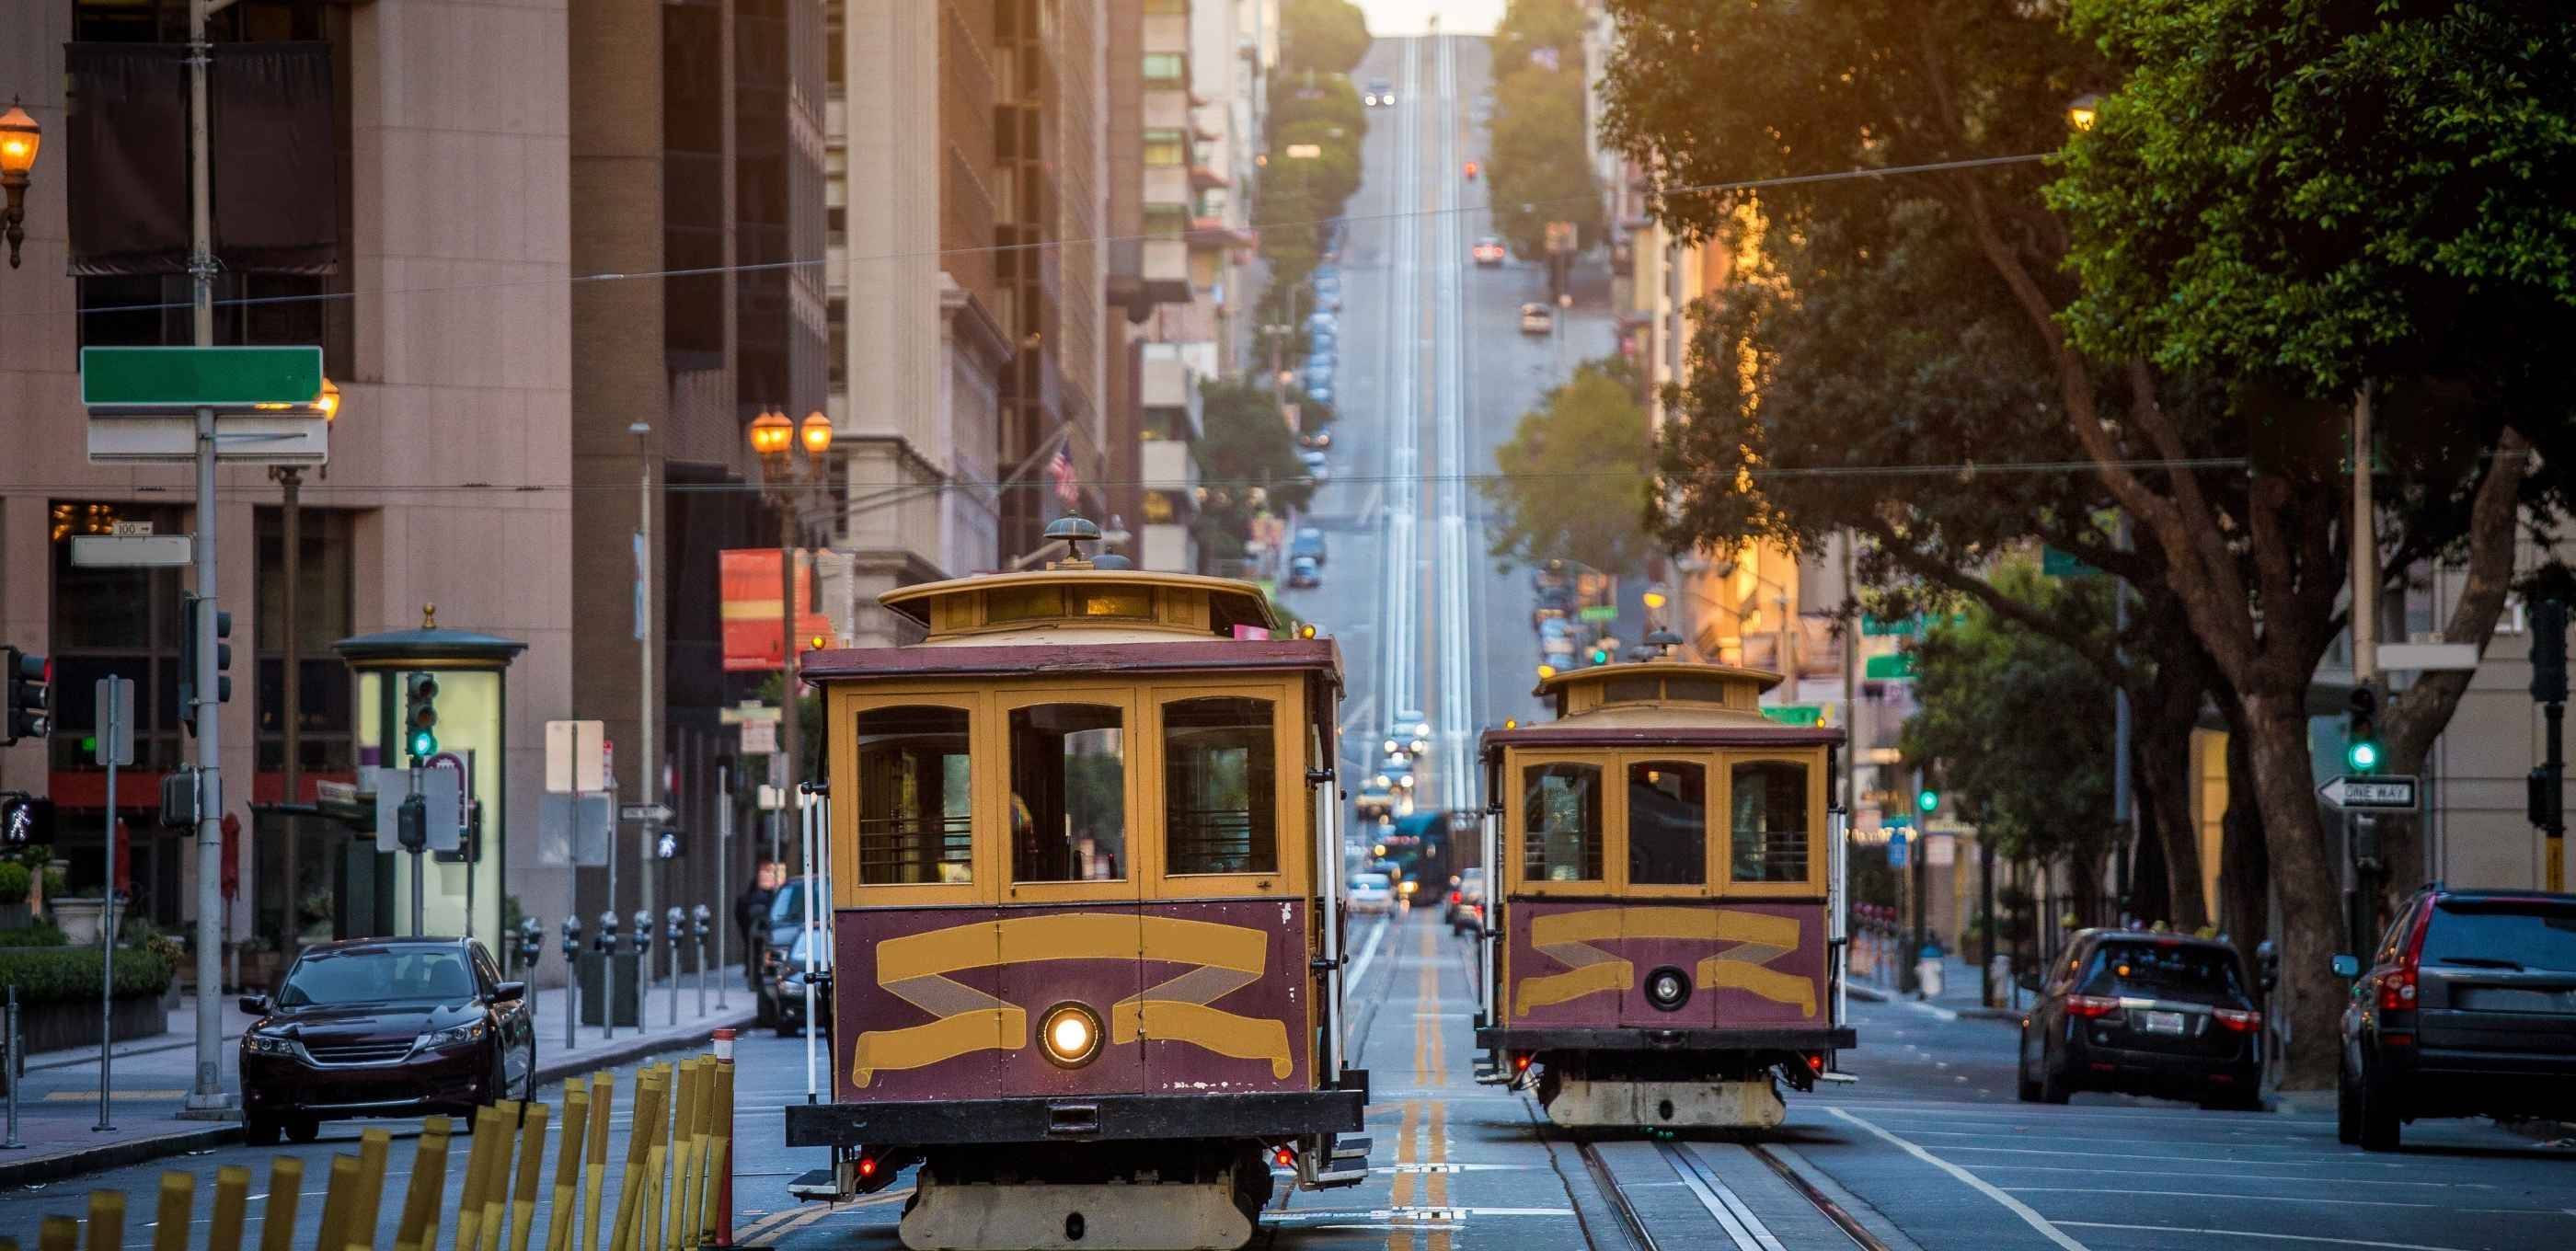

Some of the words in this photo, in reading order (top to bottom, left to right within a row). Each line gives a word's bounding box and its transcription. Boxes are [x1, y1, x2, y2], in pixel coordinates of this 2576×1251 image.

[119, 522, 136, 534] 100
[2345, 784, 2373, 798] ONE
[2376, 784, 2402, 798] WAY
